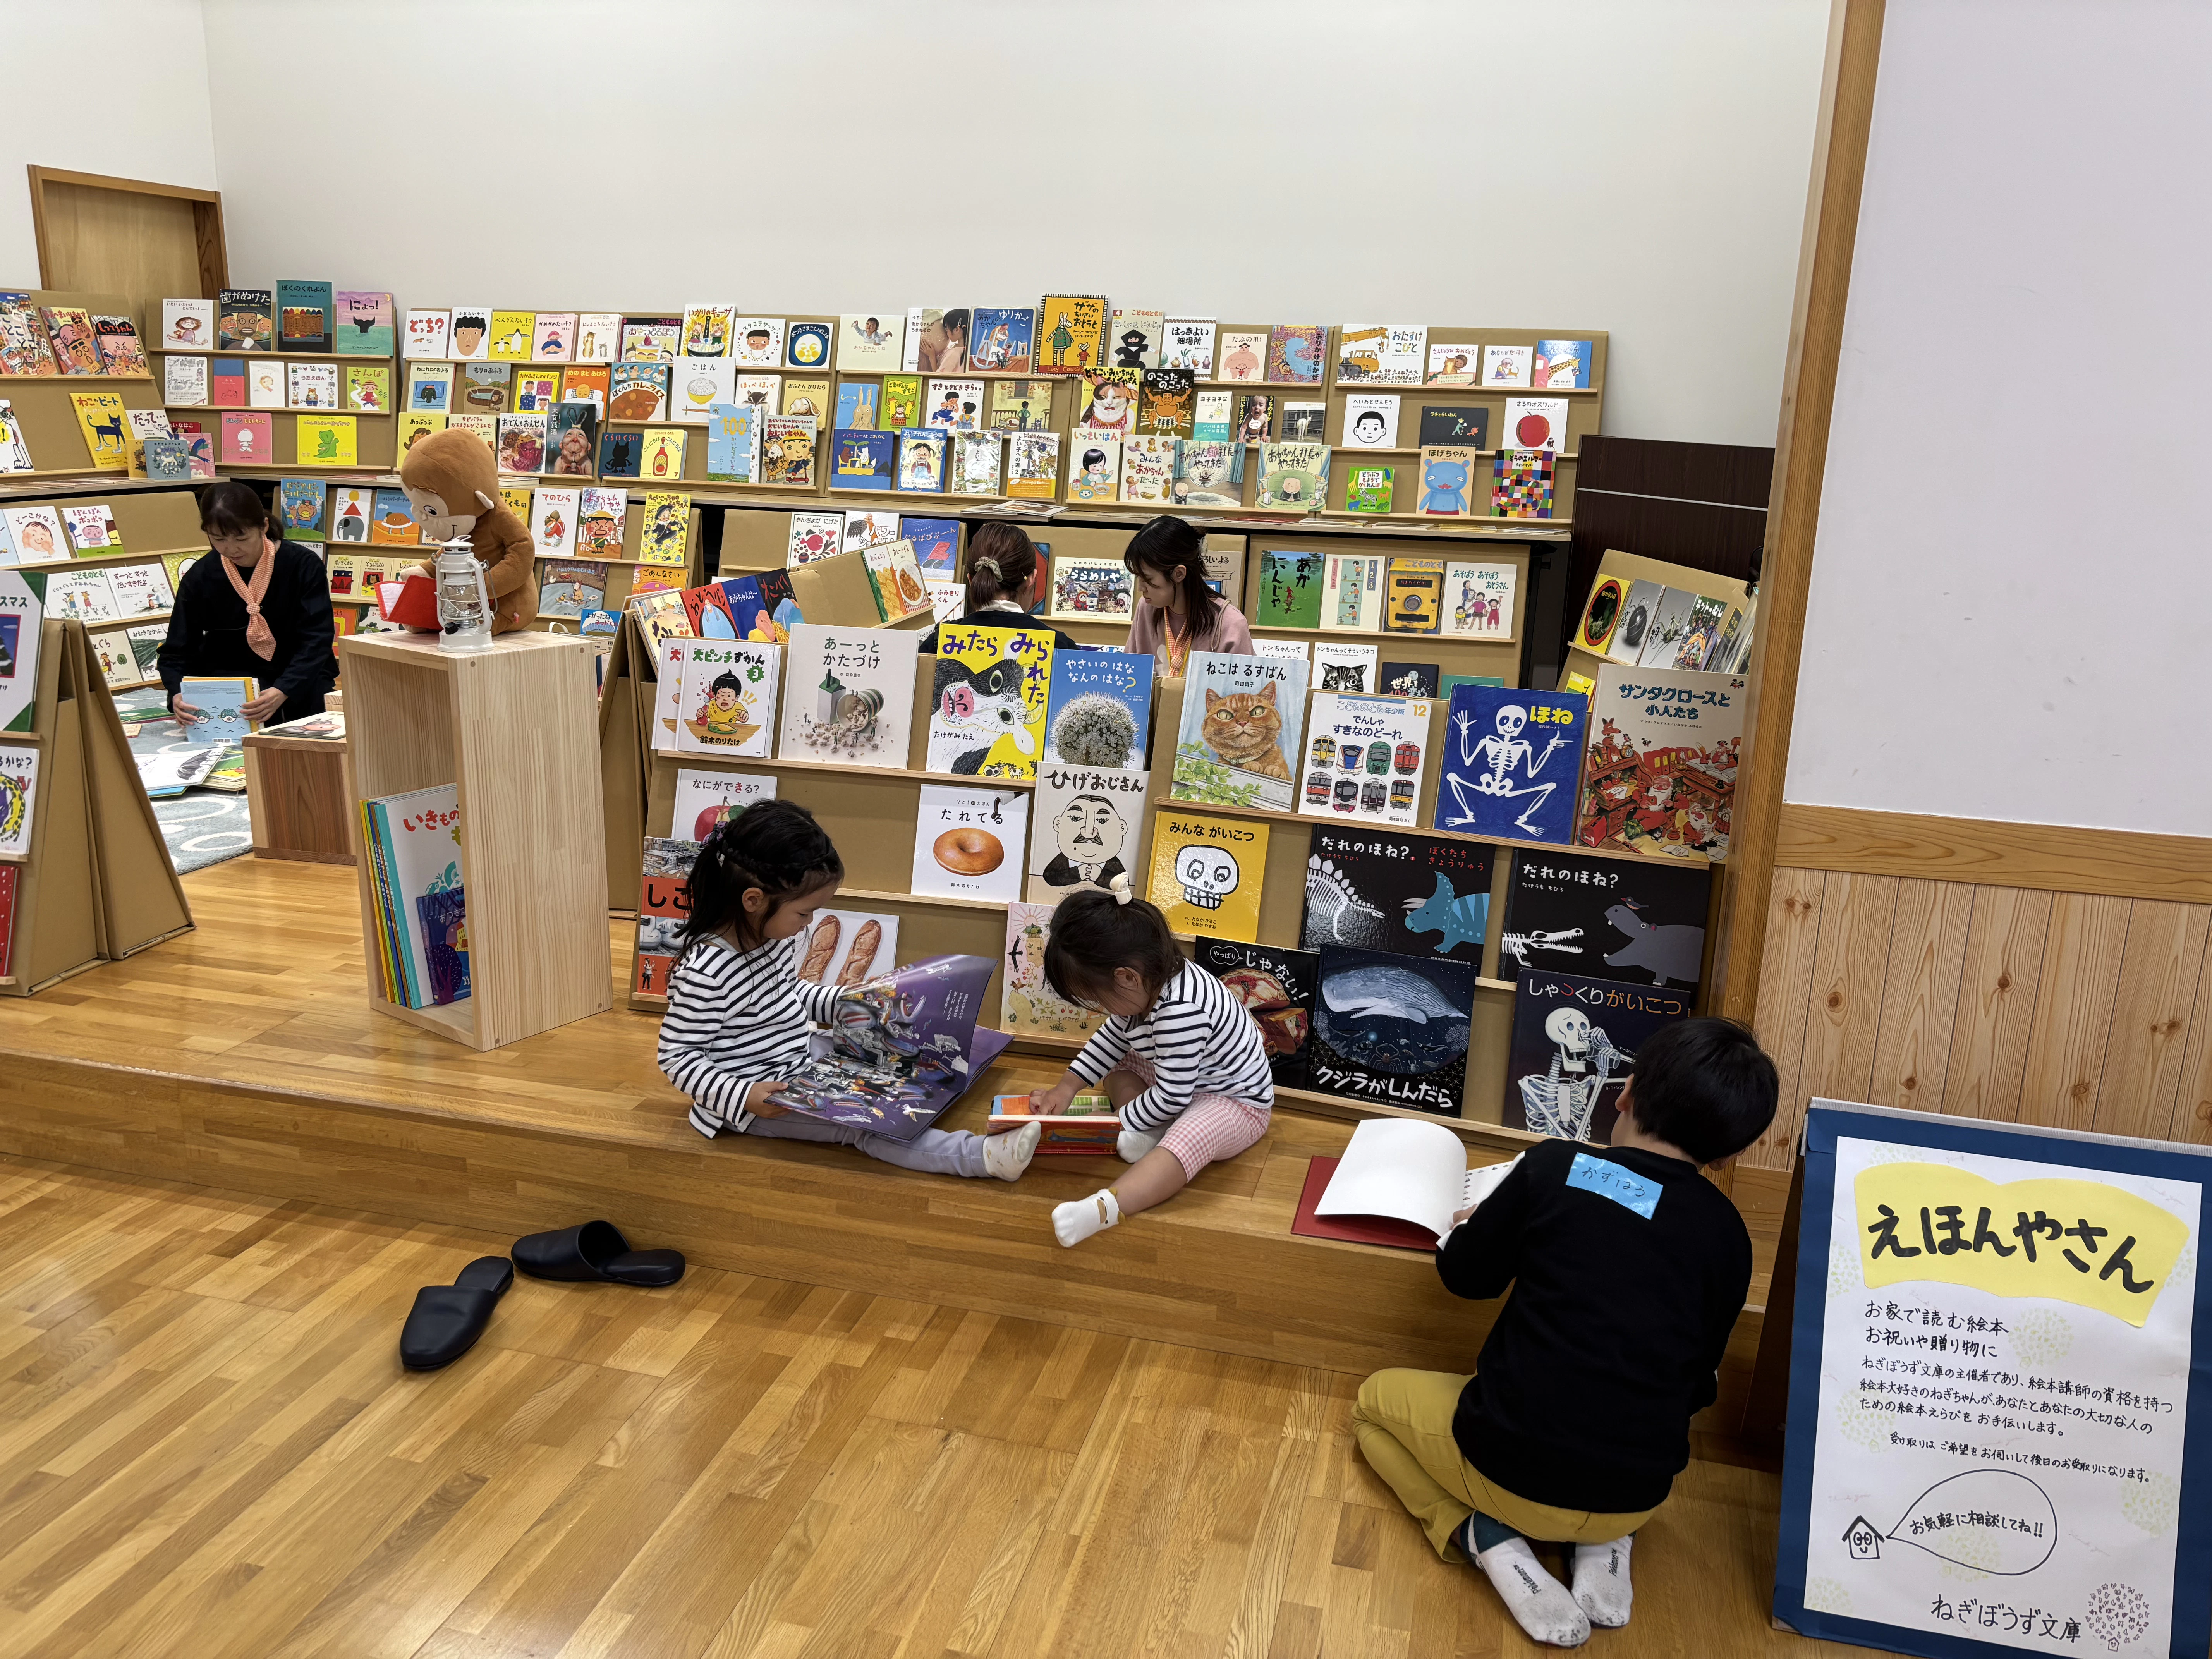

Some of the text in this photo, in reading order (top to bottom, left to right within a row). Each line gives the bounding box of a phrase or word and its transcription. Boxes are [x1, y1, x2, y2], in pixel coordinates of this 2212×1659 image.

[220, 292, 271, 305] 歯がぬけた
[999, 310, 1029, 326] ゆりかご
[1073, 318, 1098, 329] おとうと
[98, 323, 132, 333] しってるわん
[410, 318, 444, 334] どっち?
[629, 328, 675, 336] おやつどろぼう
[1172, 327, 1209, 336] はっきよい
[1392, 331, 1422, 341] おたすけ
[1395, 343, 1417, 353] こびと
[1312, 334, 1322, 381] ふりかけのかぜ
[353, 369, 384, 377] さんぽ
[1147, 372, 1178, 381] のこった
[1159, 380, 1189, 389] のこった
[720, 417, 746, 435] 100
[1074, 431, 1118, 441] いっさいはん
[1140, 453, 1162, 463] みんな
[1429, 449, 1467, 457] ほげちゃん
[1136, 464, 1164, 476] あかちゃん
[1194, 459, 1222, 470] やってきた
[1278, 459, 1307, 469] やってきた
[1139, 476, 1159, 485] だった
[542, 494, 571, 502] てのひら
[870, 526, 895, 537] パワー
[71, 570, 105, 580] こどものとも
[643, 569, 680, 577] ごめんなさい
[1071, 569, 1120, 581] うらめしや
[1296, 557, 1311, 589] あか
[1453, 569, 1499, 580] あそぼう あそぼう
[1271, 557, 1286, 608] にんじゃ
[1486, 581, 1509, 590] おとうさん
[133, 628, 163, 637] おおきなかぶ
[825, 637, 880, 654] あーっと
[942, 630, 997, 657] みたら
[1263, 644, 1301, 653] トンちゃんって
[693, 647, 765, 665] 大ピンチずかん
[823, 653, 881, 670] かたづけ
[1066, 659, 1135, 673] やさいの はな
[1207, 661, 1287, 681] ねこは るすばん
[750, 669, 760, 680] 3
[1069, 672, 1098, 683] なんの
[1619, 684, 1731, 707] サンタクロースと
[1413, 704, 1427, 717] 12
[1530, 706, 1573, 724] ほね
[1645, 704, 1698, 720] 小人たち
[1353, 716, 1384, 725] でんしゃ
[934, 730, 975, 741] たけがみ たえ
[1333, 724, 1403, 740] すきなのどーれ
[700, 735, 740, 746] 鈴木のりたけ
[693, 779, 760, 795] なにができる?
[1044, 769, 1144, 793] ひげおじさん
[941, 809, 1003, 825] たれてる
[1170, 822, 1255, 842] みんな がいこつ
[1429, 847, 1467, 858] ぼくたち
[1429, 858, 1485, 871] きょうりゅう
[1523, 864, 1619, 889] だれのほね?
[1213, 950, 1236, 960] やっぱり
[1528, 979, 1682, 1015] しゃっくりがいこつ
[1317, 1066, 1453, 1108] クジラがしんだら
[1868, 1204, 2154, 1293] えほんやさん
[1866, 1301, 2008, 1334] お家で読む絵本
[1866, 1327, 1997, 1358] お祝いや贈り物に
[1931, 1594, 2081, 1642] ねぎぼうず文庫
